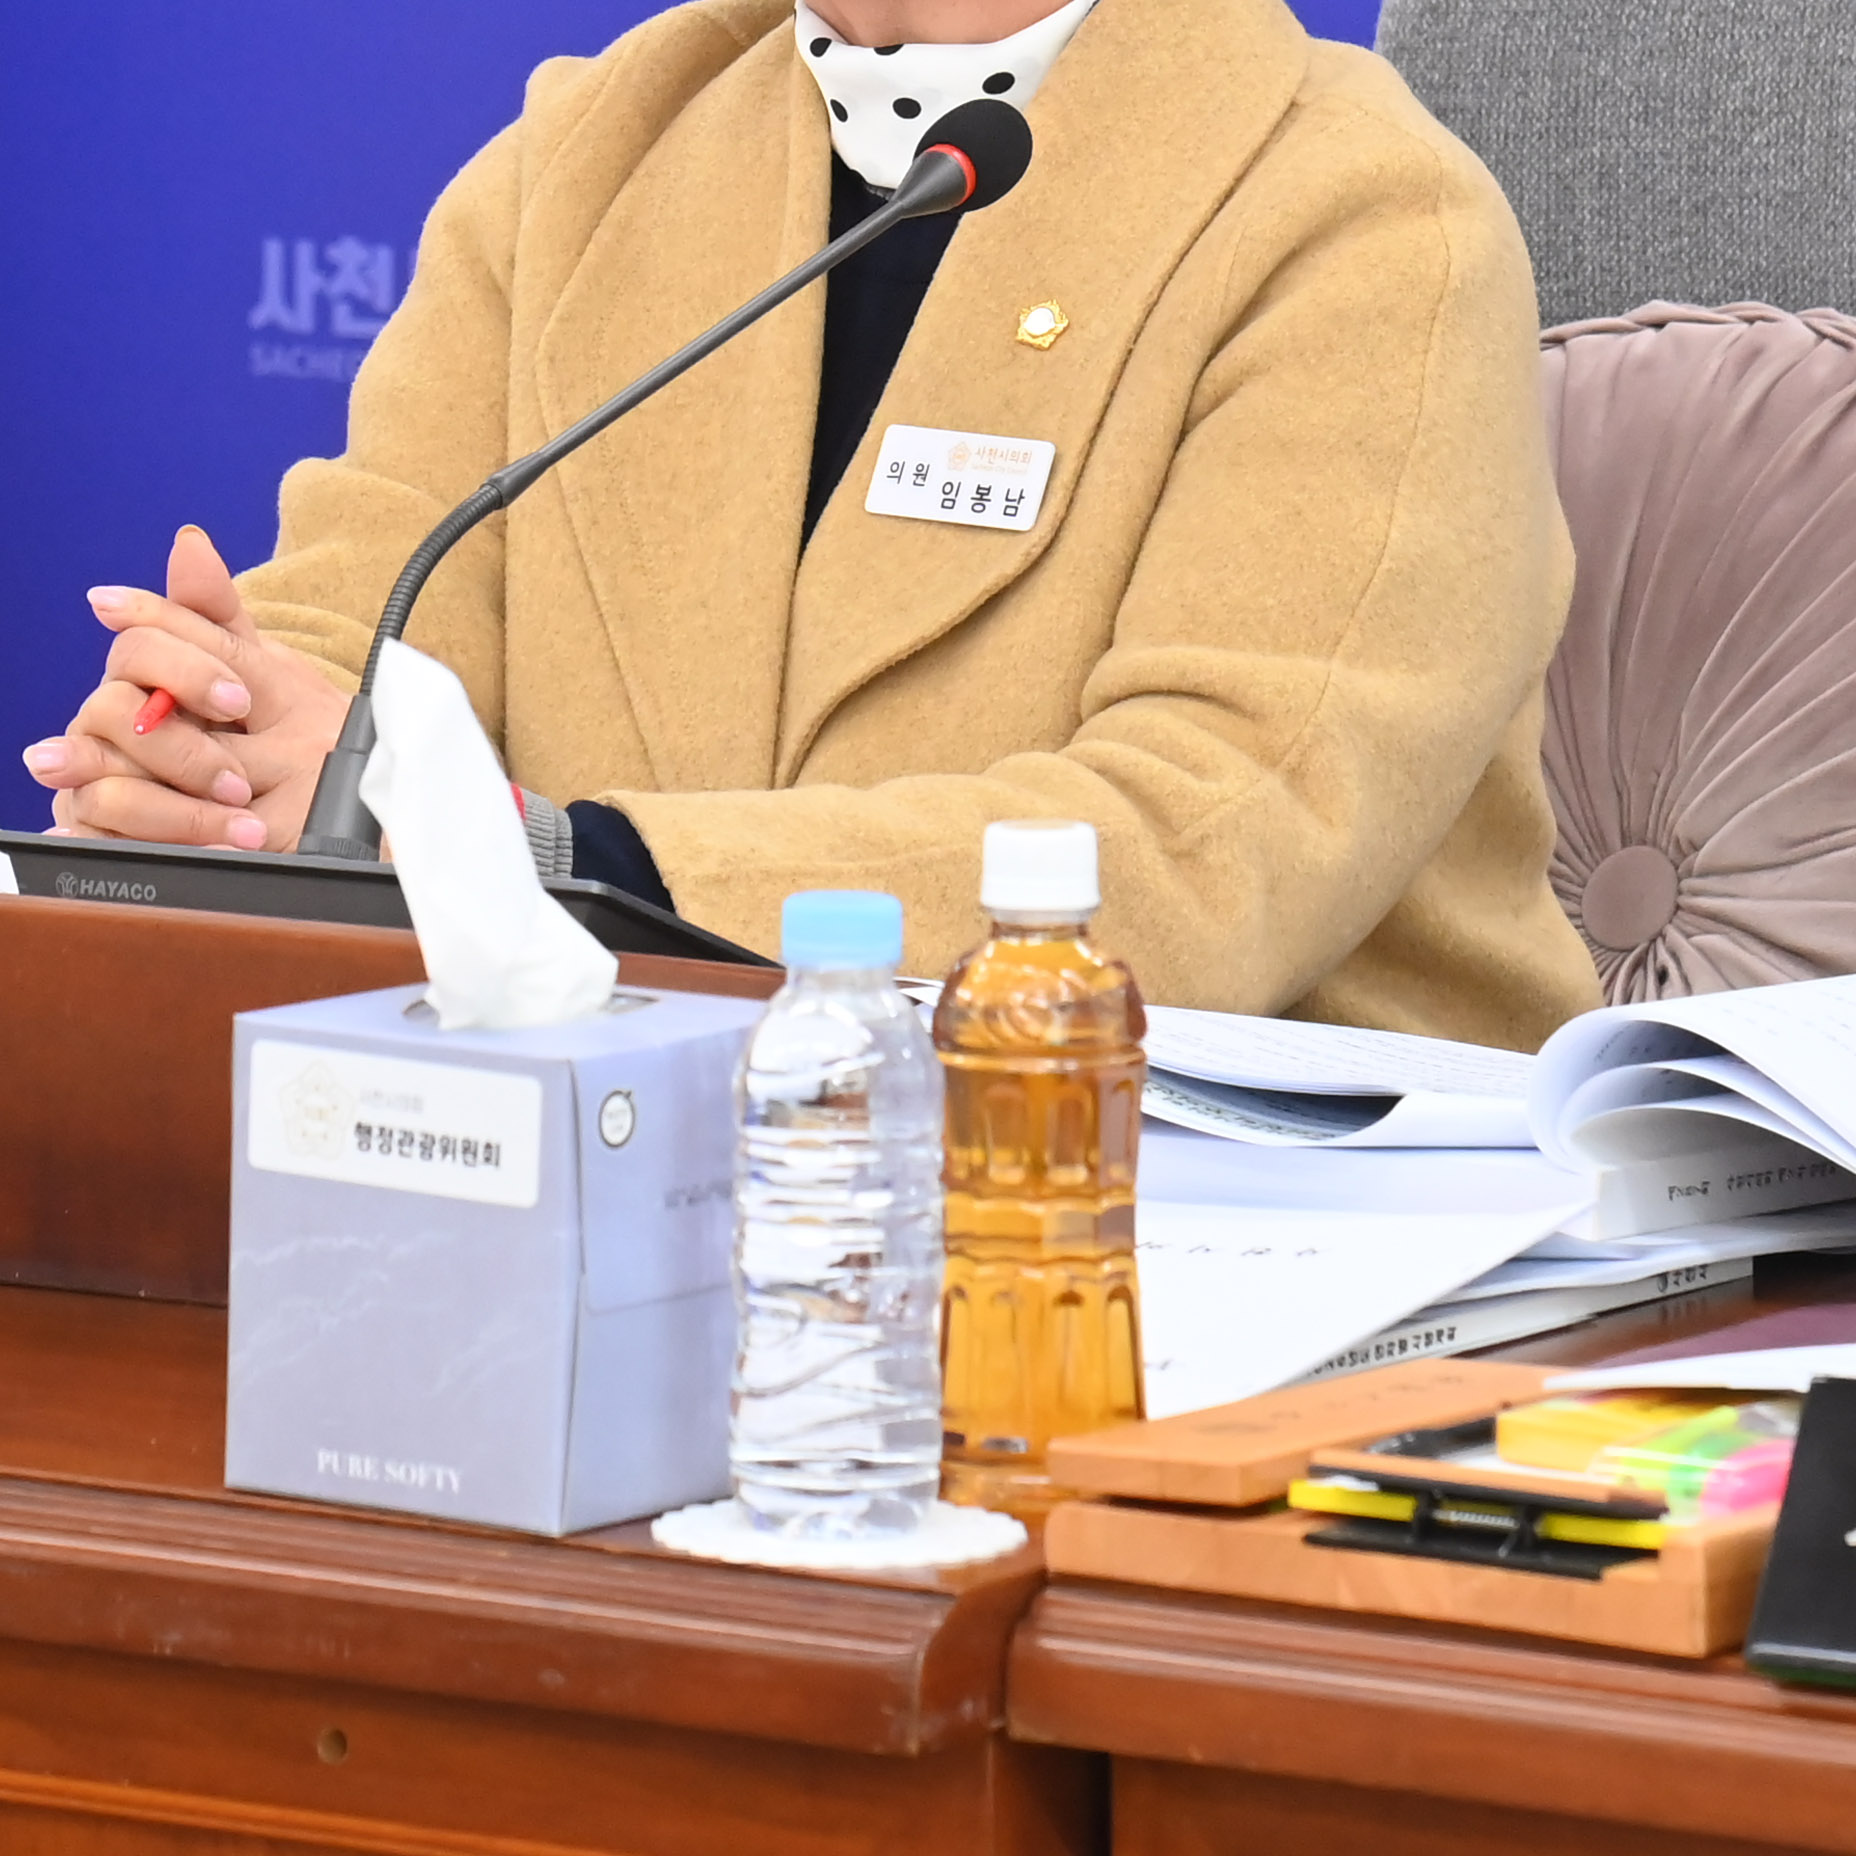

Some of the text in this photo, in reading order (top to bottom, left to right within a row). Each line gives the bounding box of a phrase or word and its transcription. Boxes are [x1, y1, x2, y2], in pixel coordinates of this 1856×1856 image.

[887, 462, 929, 486] 의원
[941, 482, 1025, 517] 임봉남
[79, 879, 157, 902] HAYACO
[355, 1122, 500, 1167] 행정관광위원회
[317, 1448, 461, 1495] PURE SOFTY
